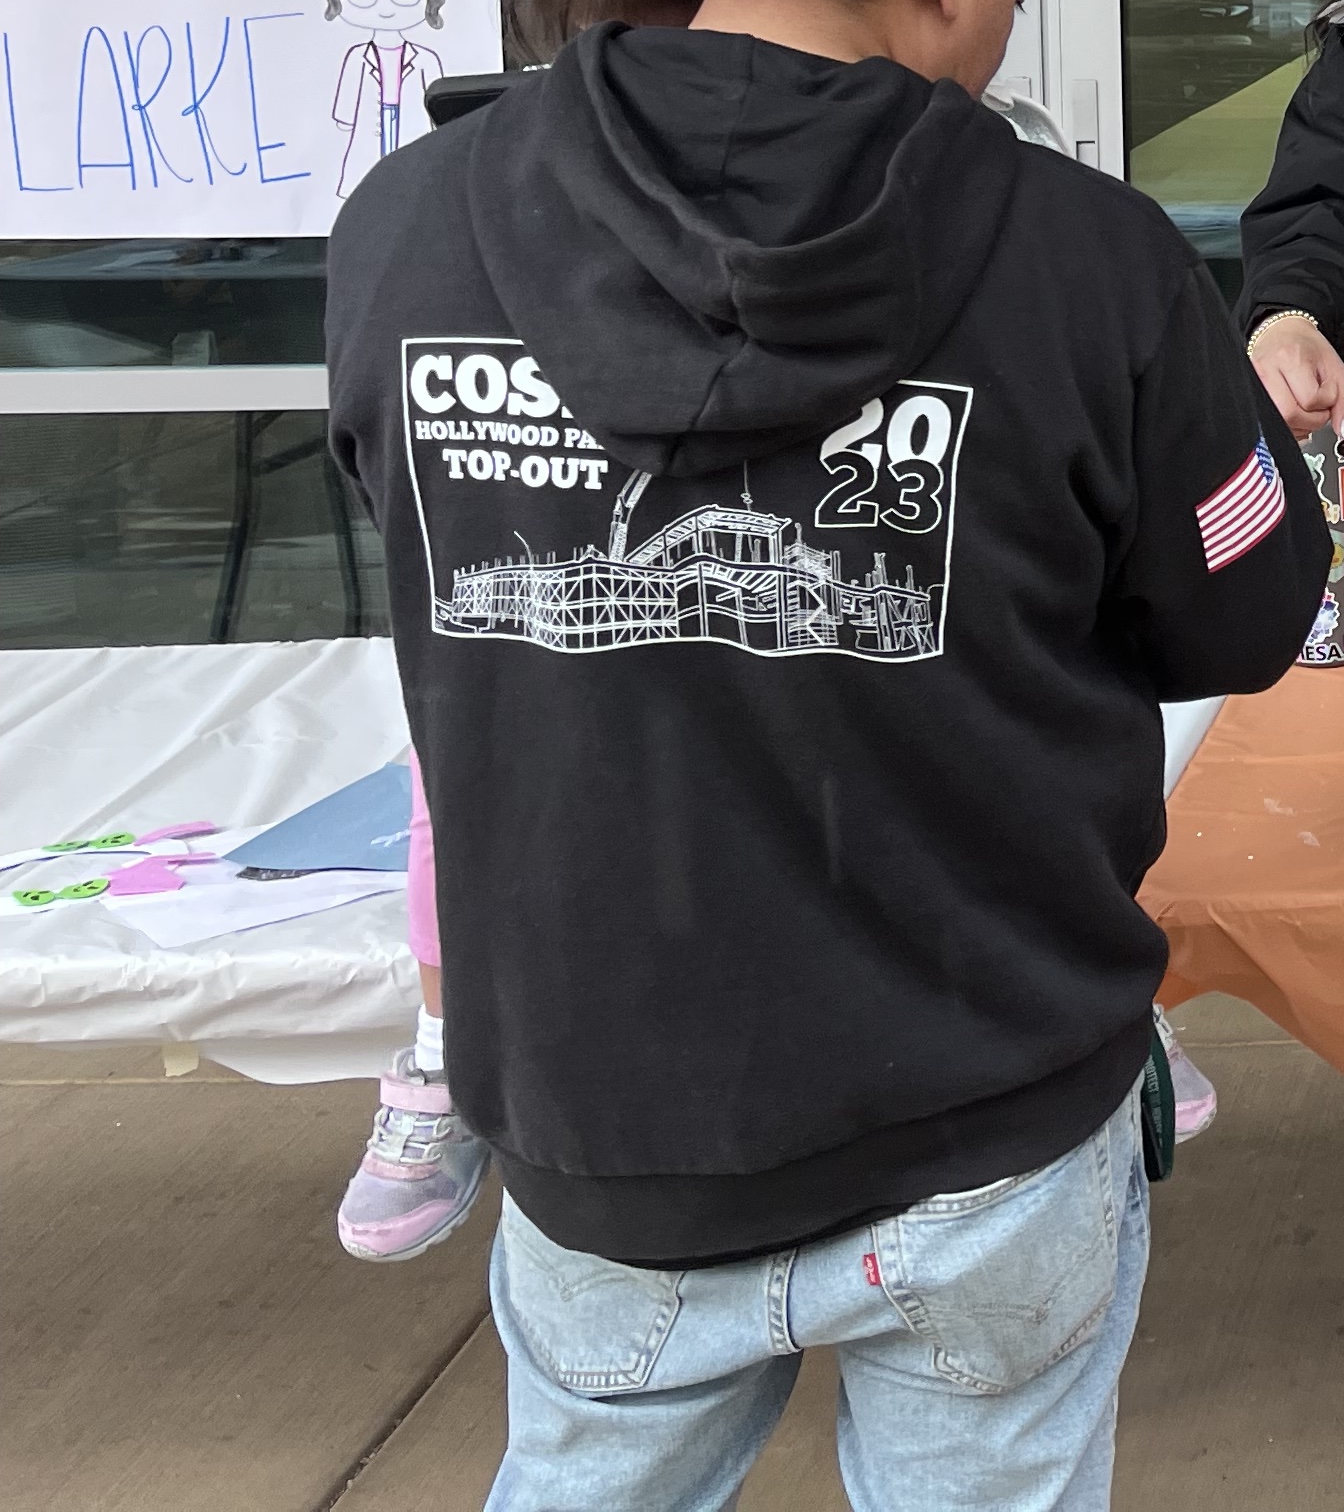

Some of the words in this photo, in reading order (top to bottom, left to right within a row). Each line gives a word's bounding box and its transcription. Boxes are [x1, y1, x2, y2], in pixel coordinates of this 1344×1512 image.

[410, 354, 575, 419] COS
[414, 419, 561, 449] HOLLYWOOD
[442, 446, 609, 491] TOP-OUT
[814, 449, 945, 535] 23
